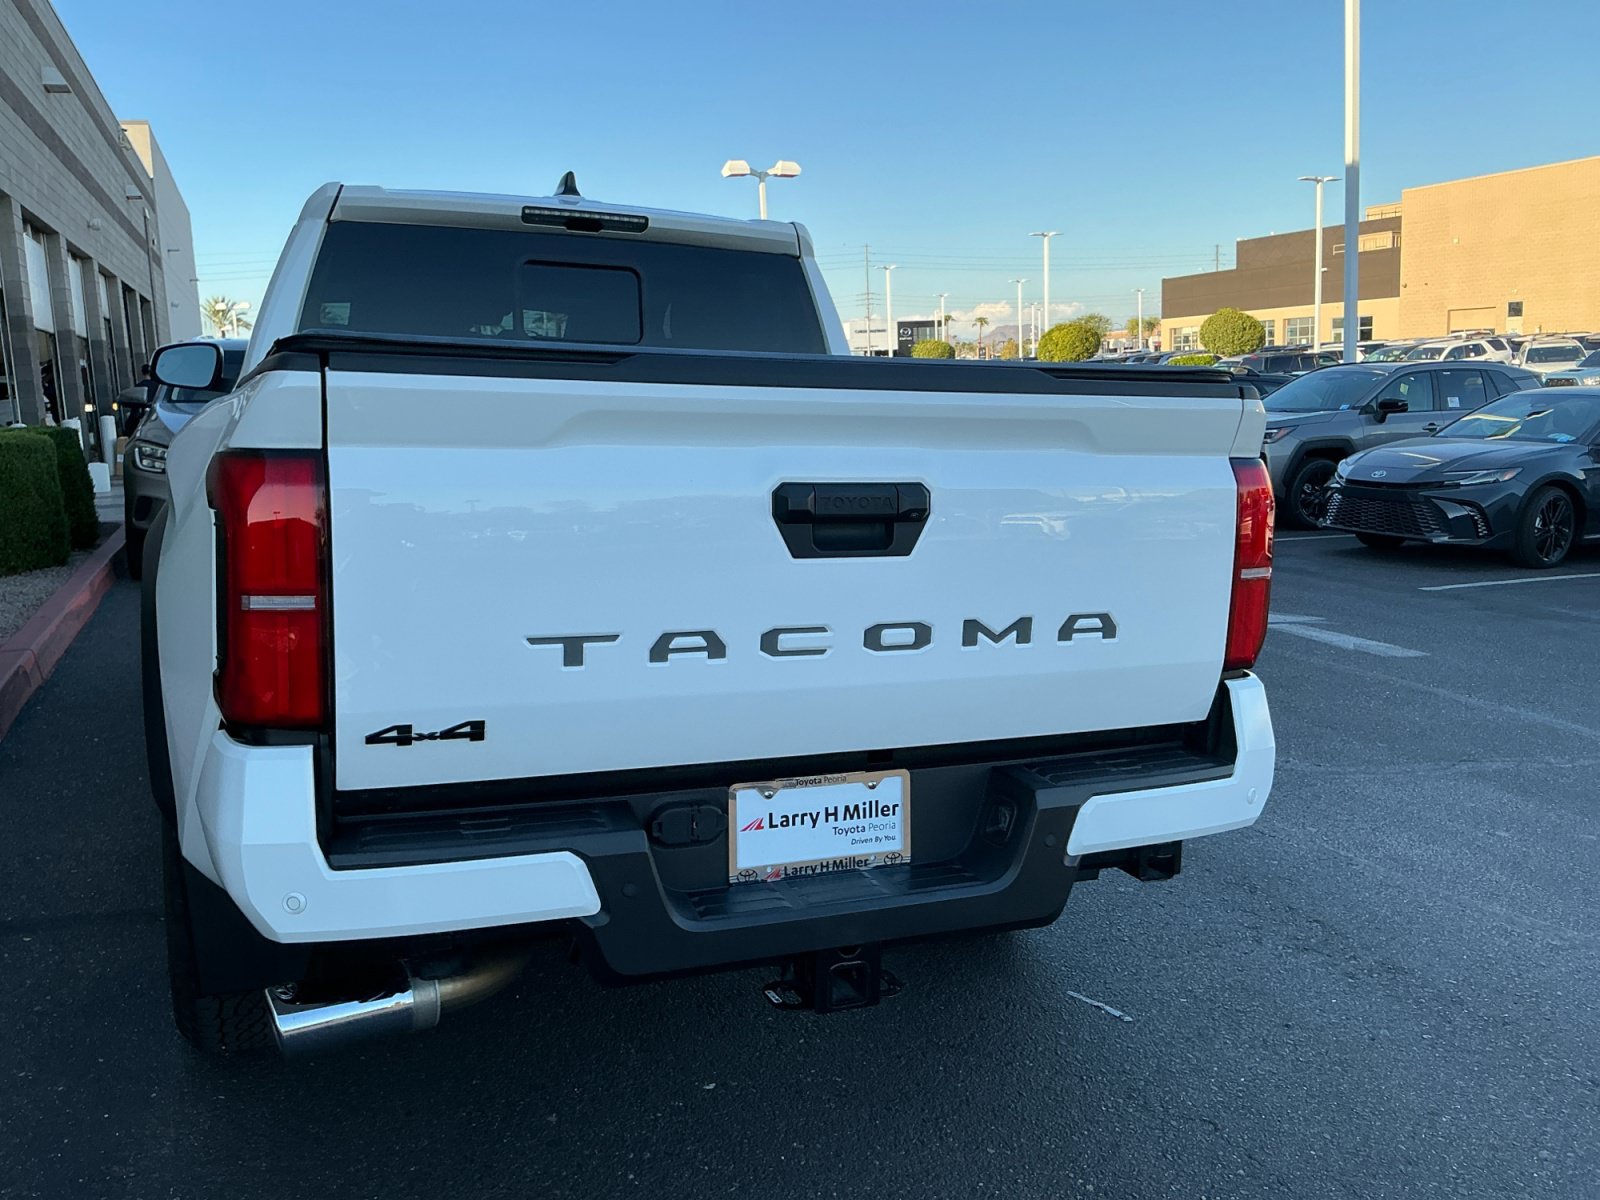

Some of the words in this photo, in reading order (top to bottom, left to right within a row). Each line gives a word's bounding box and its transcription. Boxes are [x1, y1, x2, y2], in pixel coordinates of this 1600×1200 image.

[819, 496, 895, 511] TOYOTA
[524, 611, 1120, 671] TACOMA
[365, 720, 486, 746] 4x4
[795, 777, 822, 787] Toyota
[823, 775, 847, 785] Peoria
[768, 811, 820, 829] Larry
[824, 806, 839, 823] H
[843, 800, 899, 820] Miller
[832, 825, 866, 837] Toyota
[868, 821, 896, 832] Peoria
[851, 837, 873, 846] Driven
[874, 836, 883, 844] By
[784, 864, 818, 877] Larry
[820, 861, 830, 872] H
[831, 857, 869, 871] Miller
